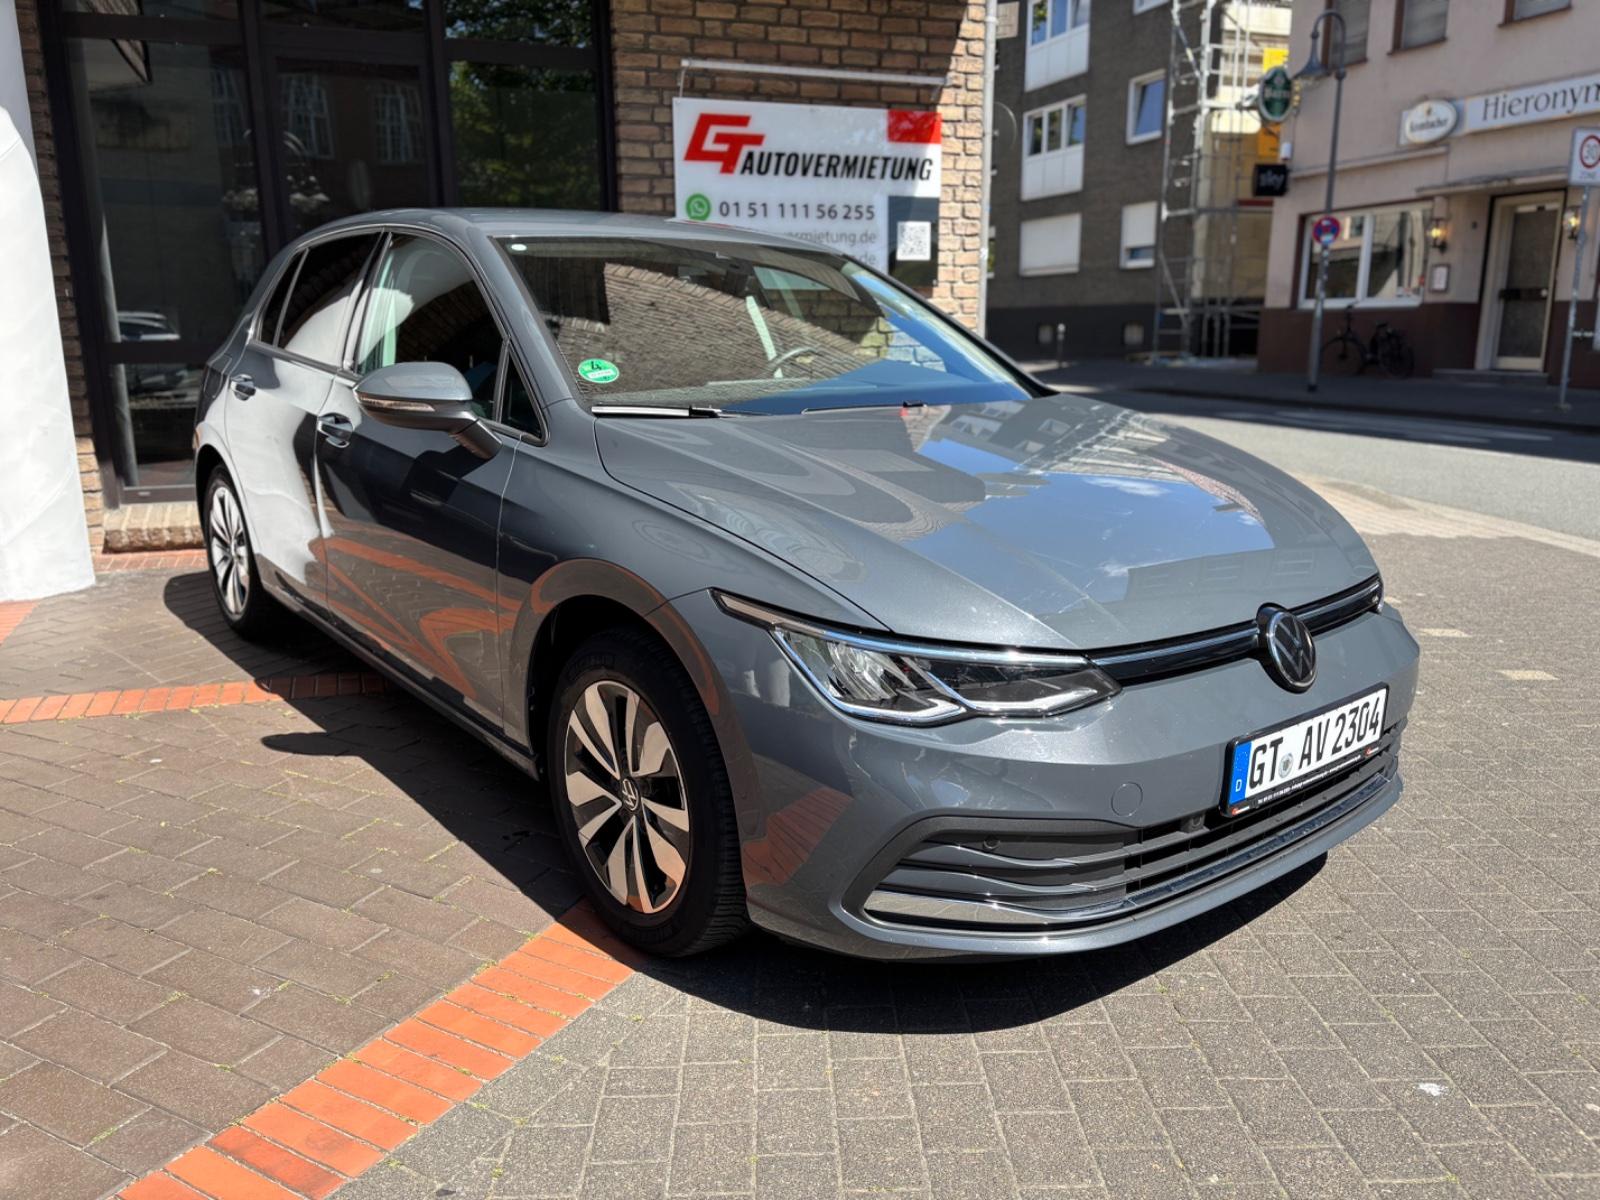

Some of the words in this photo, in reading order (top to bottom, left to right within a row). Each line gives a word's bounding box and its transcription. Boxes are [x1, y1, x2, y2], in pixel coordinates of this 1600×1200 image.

[740, 151, 933, 181] AUTOVERMIETUNG
[1248, 736, 1284, 790] GT
[1298, 718, 1331, 770] AV
[1331, 696, 1381, 756] 2304
[1235, 779, 1243, 792] D
